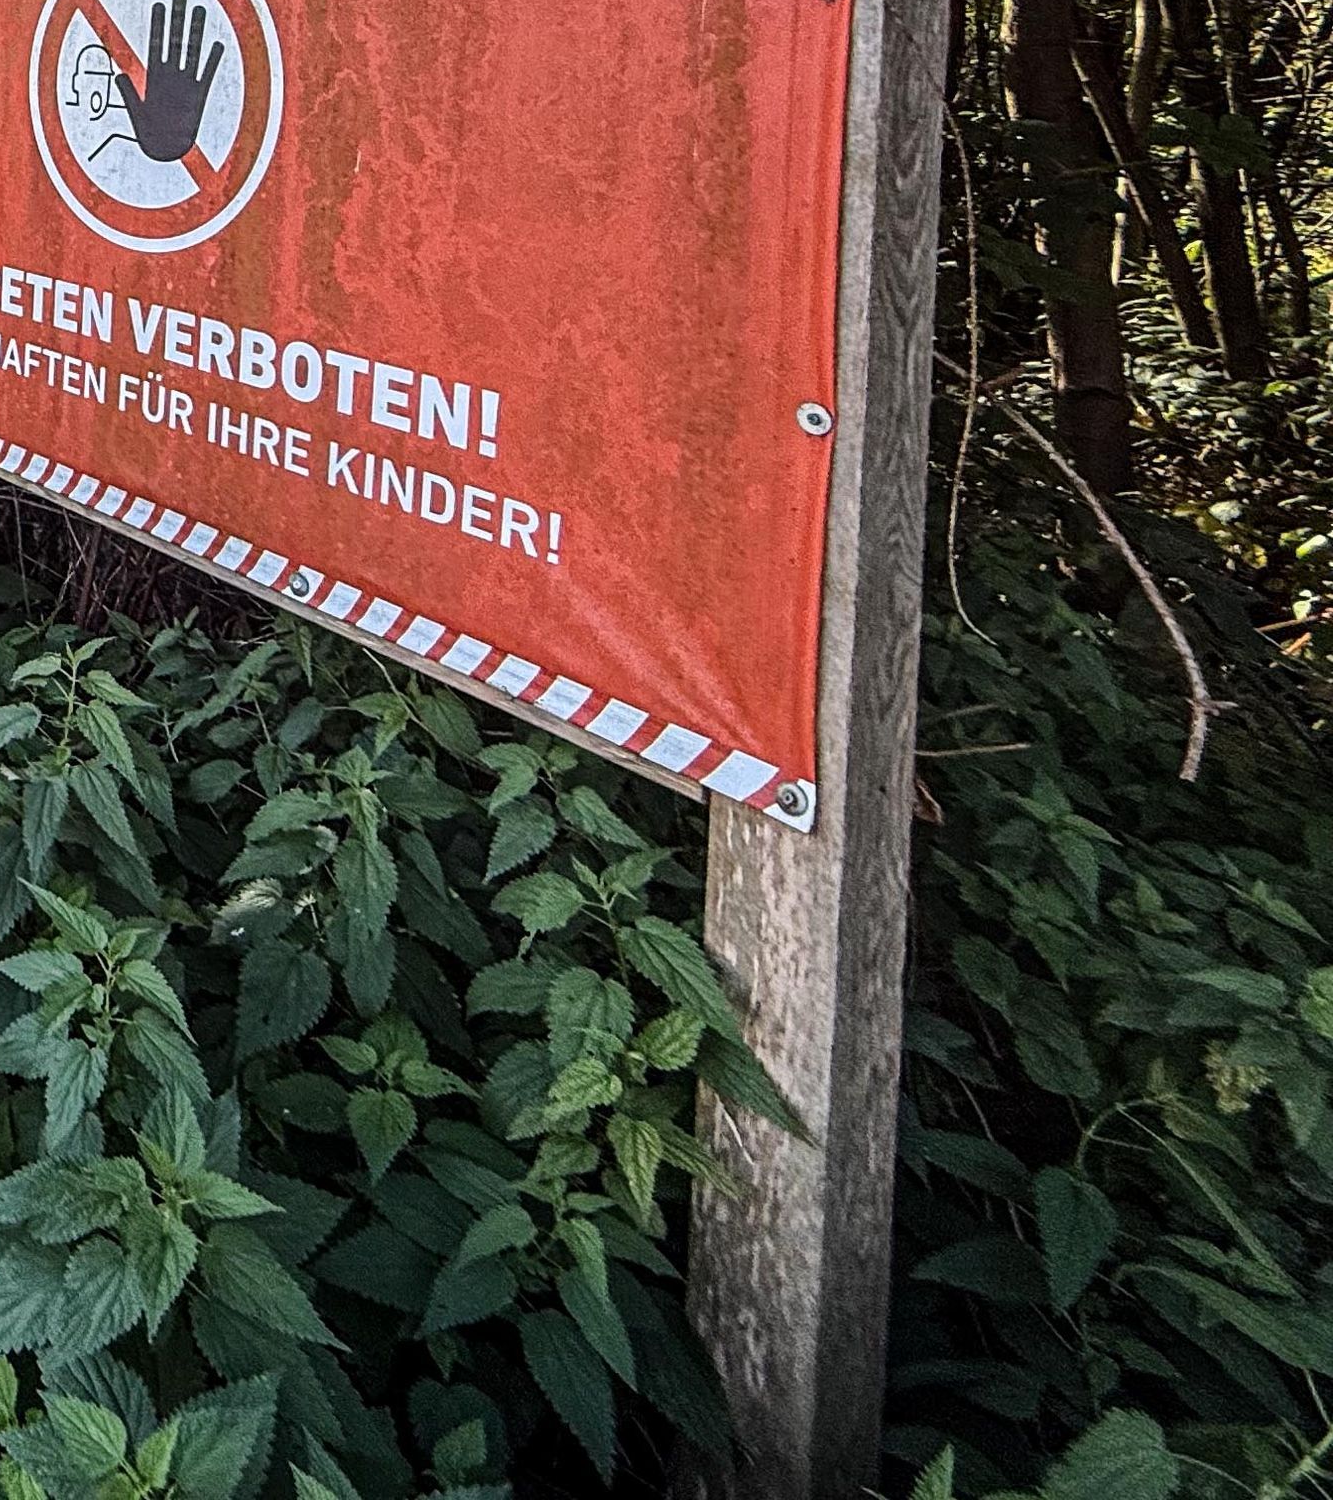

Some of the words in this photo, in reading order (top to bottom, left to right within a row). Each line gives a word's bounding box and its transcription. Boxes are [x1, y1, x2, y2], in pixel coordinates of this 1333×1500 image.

[127, 297, 501, 460] VERBOTEN!
[117, 371, 194, 436] FÜR
[207, 402, 313, 479] IHRE
[327, 440, 563, 566] KINDER!
